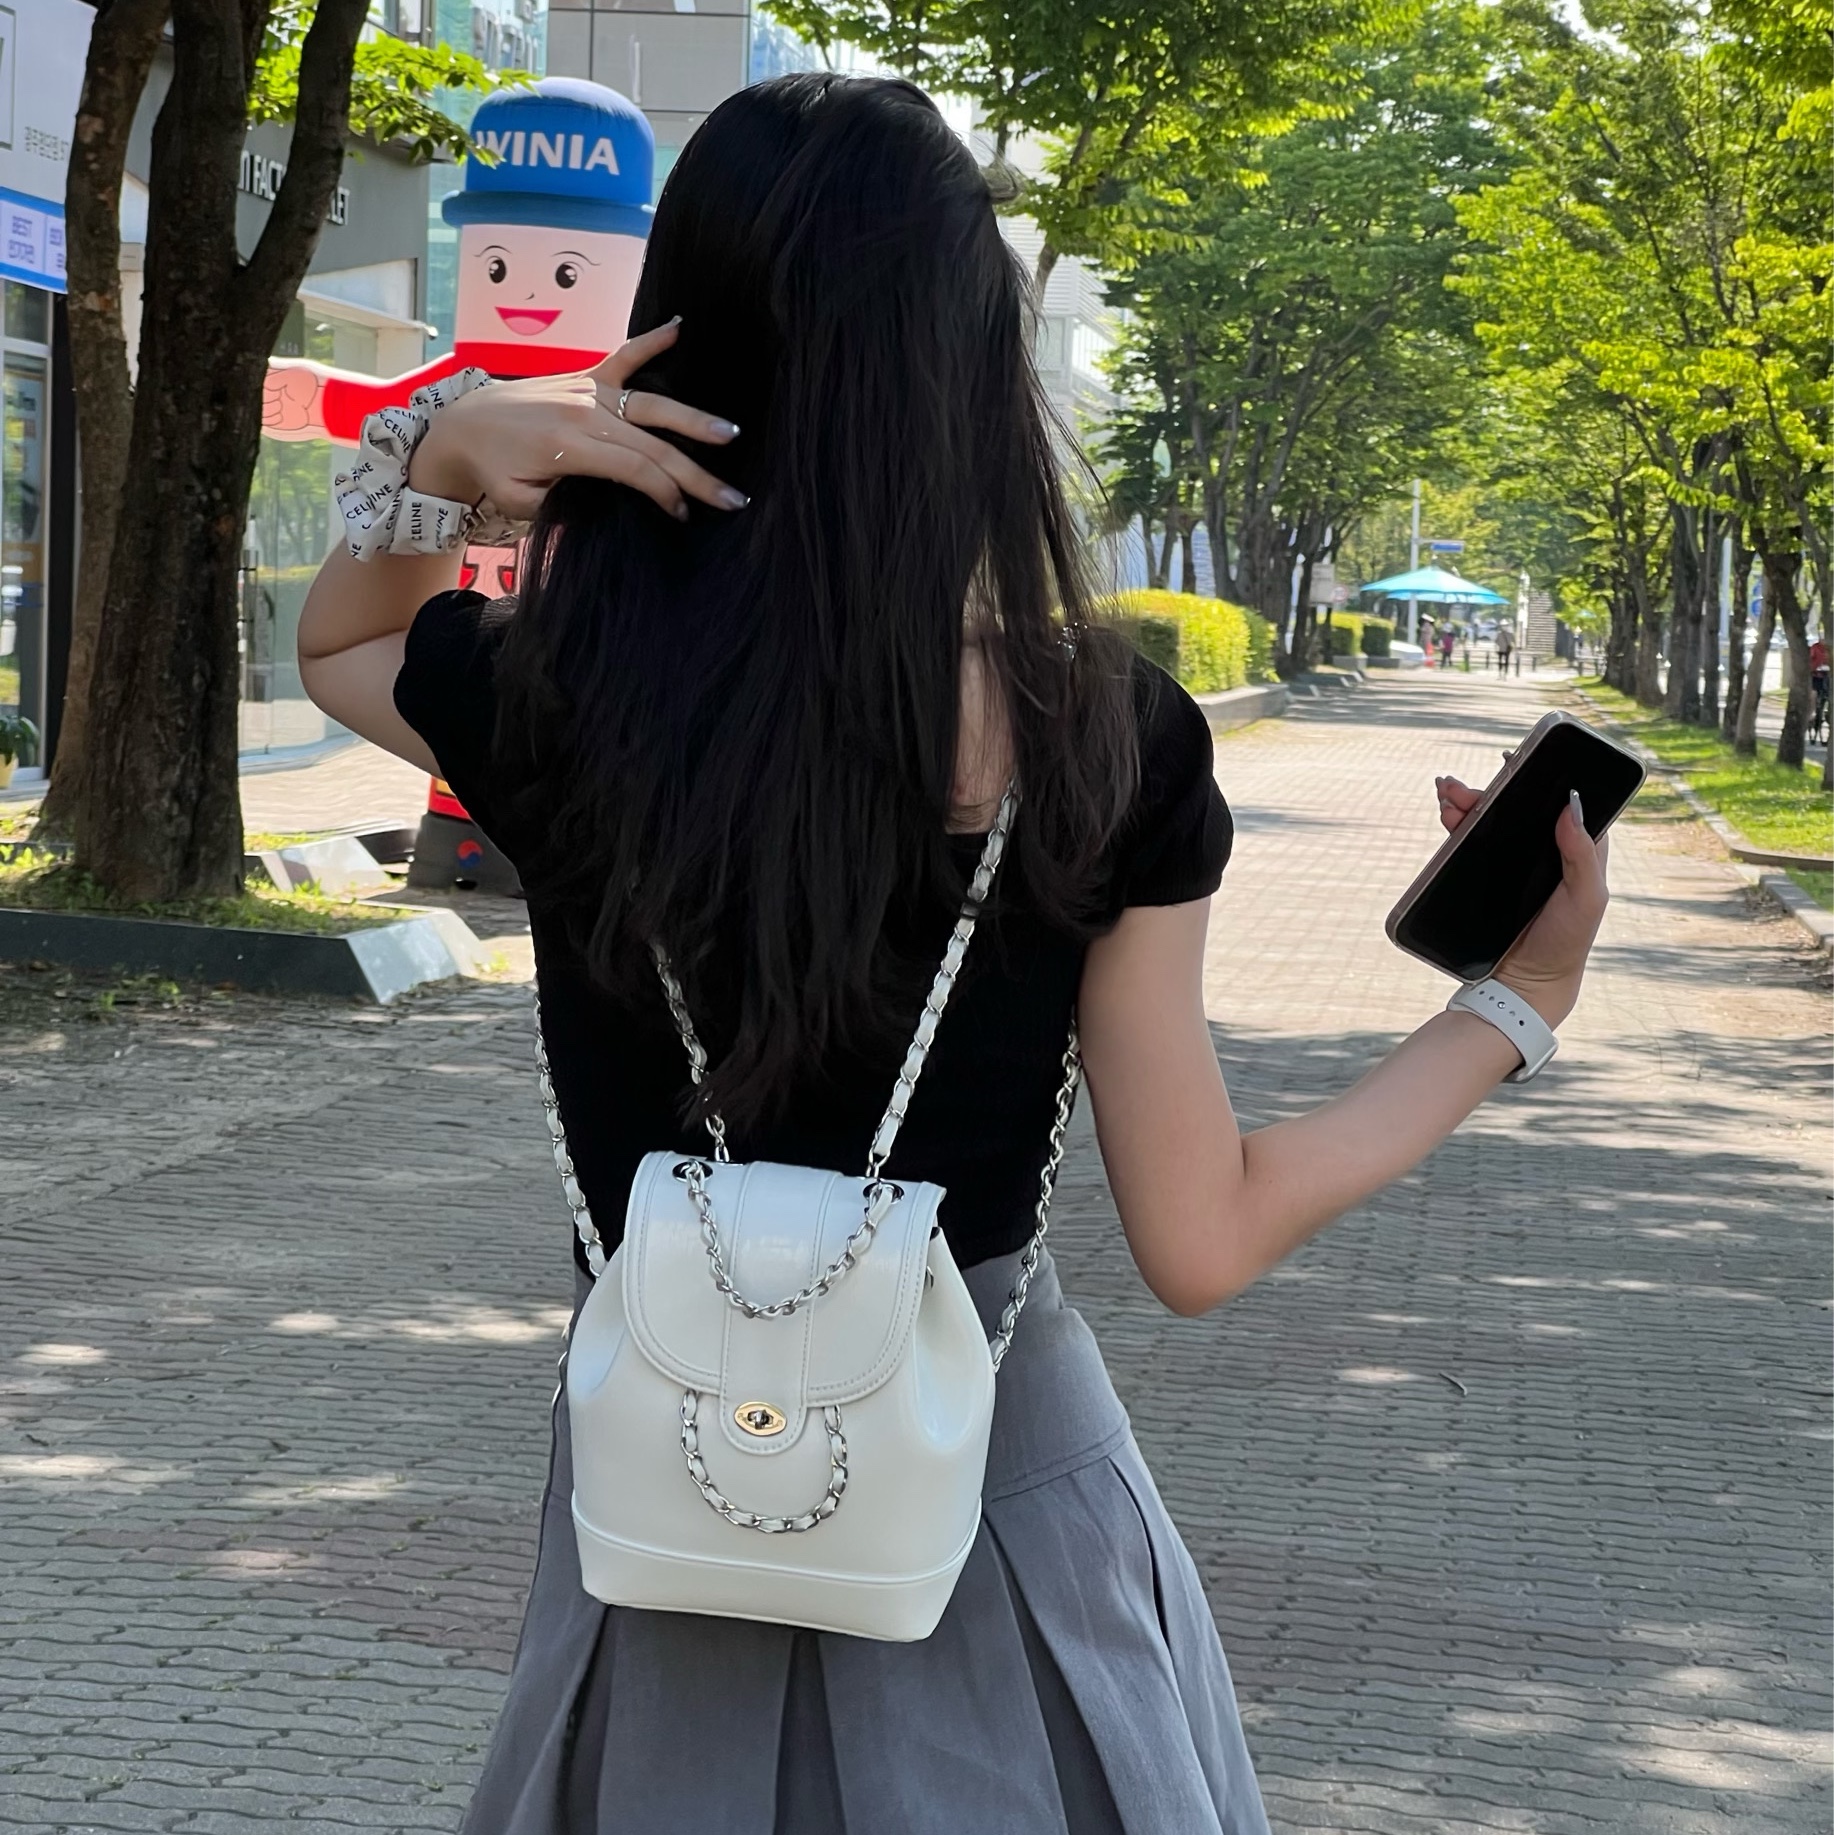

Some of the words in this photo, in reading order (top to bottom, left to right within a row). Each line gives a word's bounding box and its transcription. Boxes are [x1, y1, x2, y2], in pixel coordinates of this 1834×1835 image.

[476, 130, 620, 176] WINIA
[384, 418, 411, 453] CELINE
[411, 502, 422, 541] CELINE
